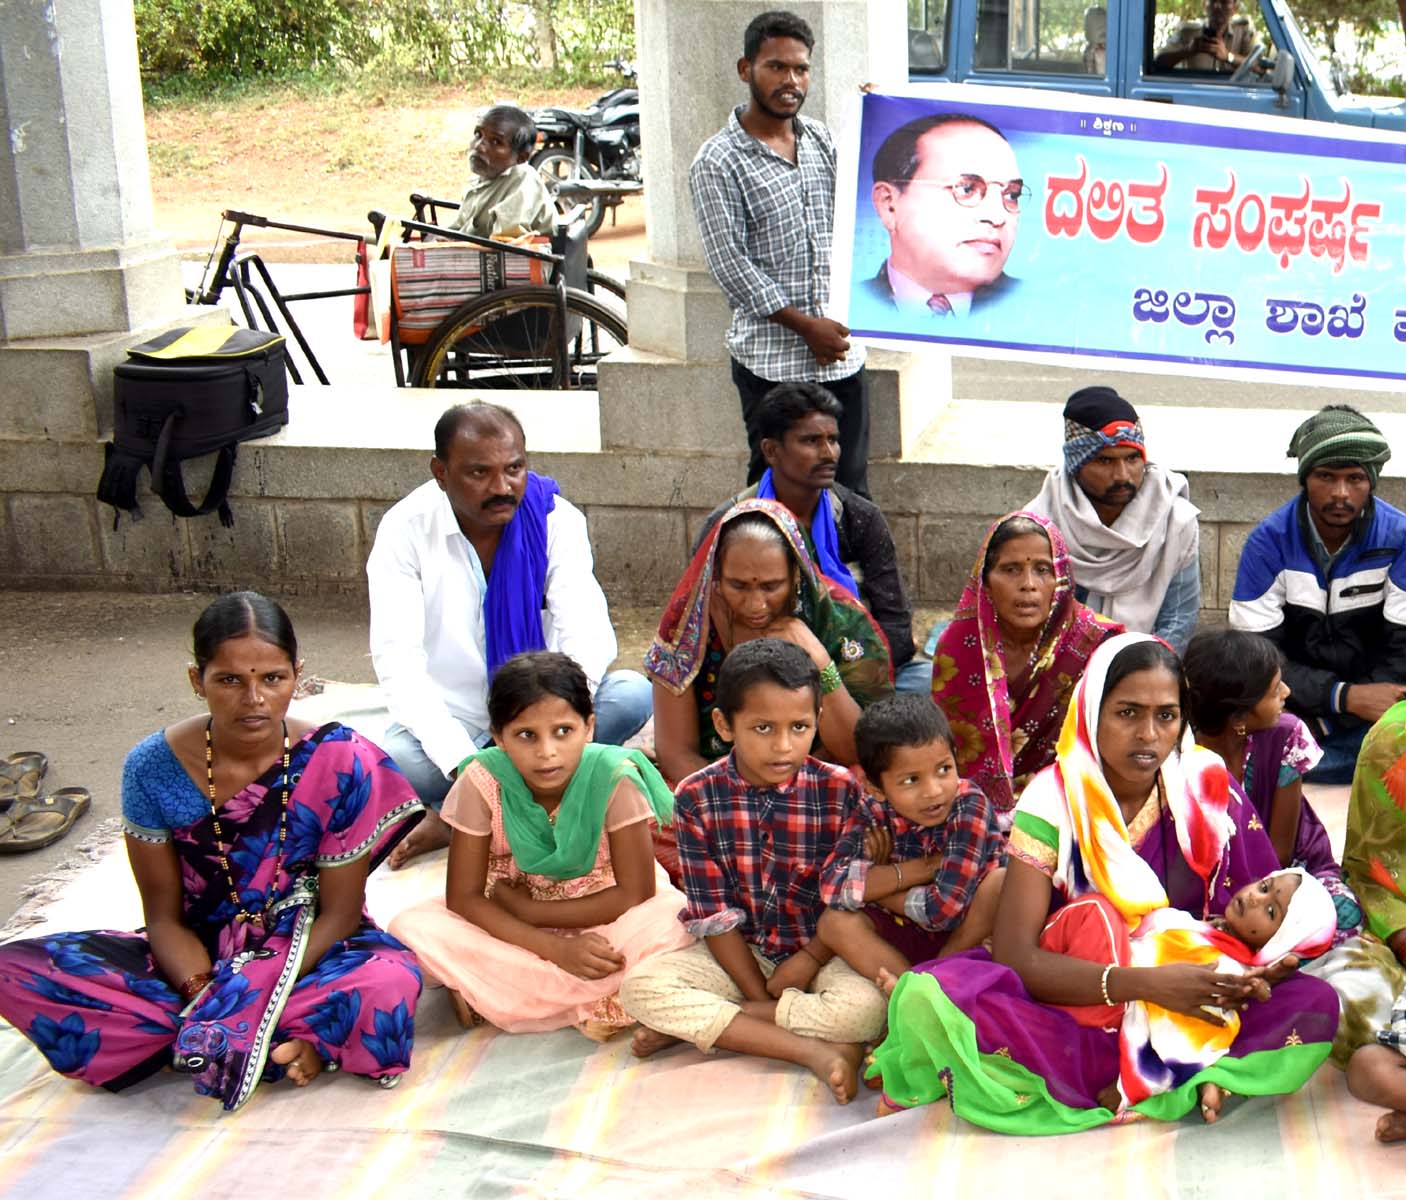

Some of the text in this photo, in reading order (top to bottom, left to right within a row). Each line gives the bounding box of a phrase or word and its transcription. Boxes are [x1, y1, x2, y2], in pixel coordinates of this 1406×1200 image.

[1045, 155, 1167, 243] ದಲಿತ
[1193, 171, 1381, 273] ಸಂಘರ್ಷ
[1132, 288, 1236, 345] ಜಿಲ್ಲಾ
[1266, 293, 1366, 338] ಶಾಖೆ
